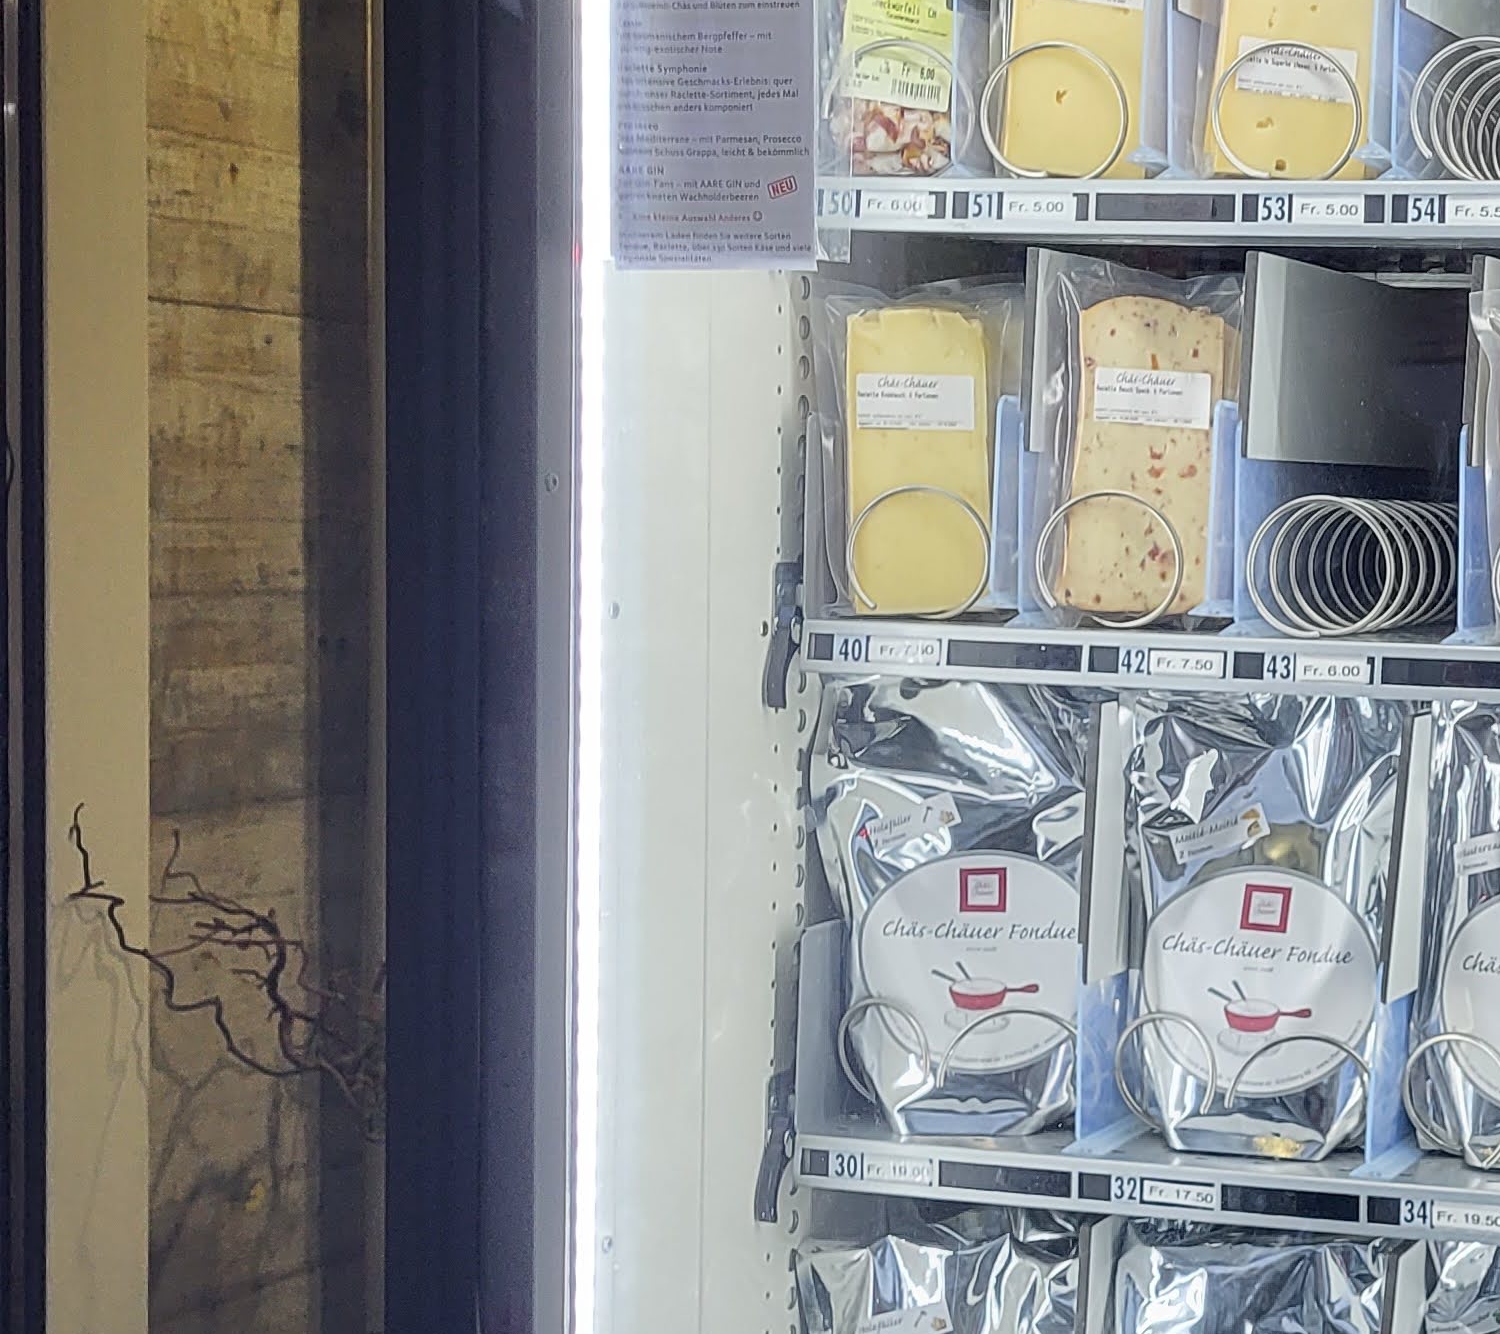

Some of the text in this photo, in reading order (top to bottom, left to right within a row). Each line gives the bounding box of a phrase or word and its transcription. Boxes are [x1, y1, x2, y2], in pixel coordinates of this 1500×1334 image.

[657, 65, 707, 74] Symphonie
[763, 135, 801, 143] Prosecco
[647, 166, 664, 175] GIN
[700, 179, 742, 188] AARE GIN
[771, 180, 794, 195] NEU
[679, 192, 759, 201] Wachholderbeeren
[972, 193, 1064, 217] 51 Fr. 5.00
[1261, 196, 1358, 220] 53 Fr. 5.00
[1411, 198, 1435, 222] 54
[1454, 205, 1475, 217] Fr.
[1121, 647, 1213, 673] 42 Fr. 7.50
[1266, 654, 1360, 680] 43 Fr. 6.00
[883, 920, 1077, 940] Chäs-Chäuer Fondue
[1163, 933, 1352, 965] Chäs-Chäuer Fondue
[1114, 1176, 1136, 1200] 32
[1403, 1200, 1427, 1224] 34
[1437, 1211, 1457, 1223] Fr.
